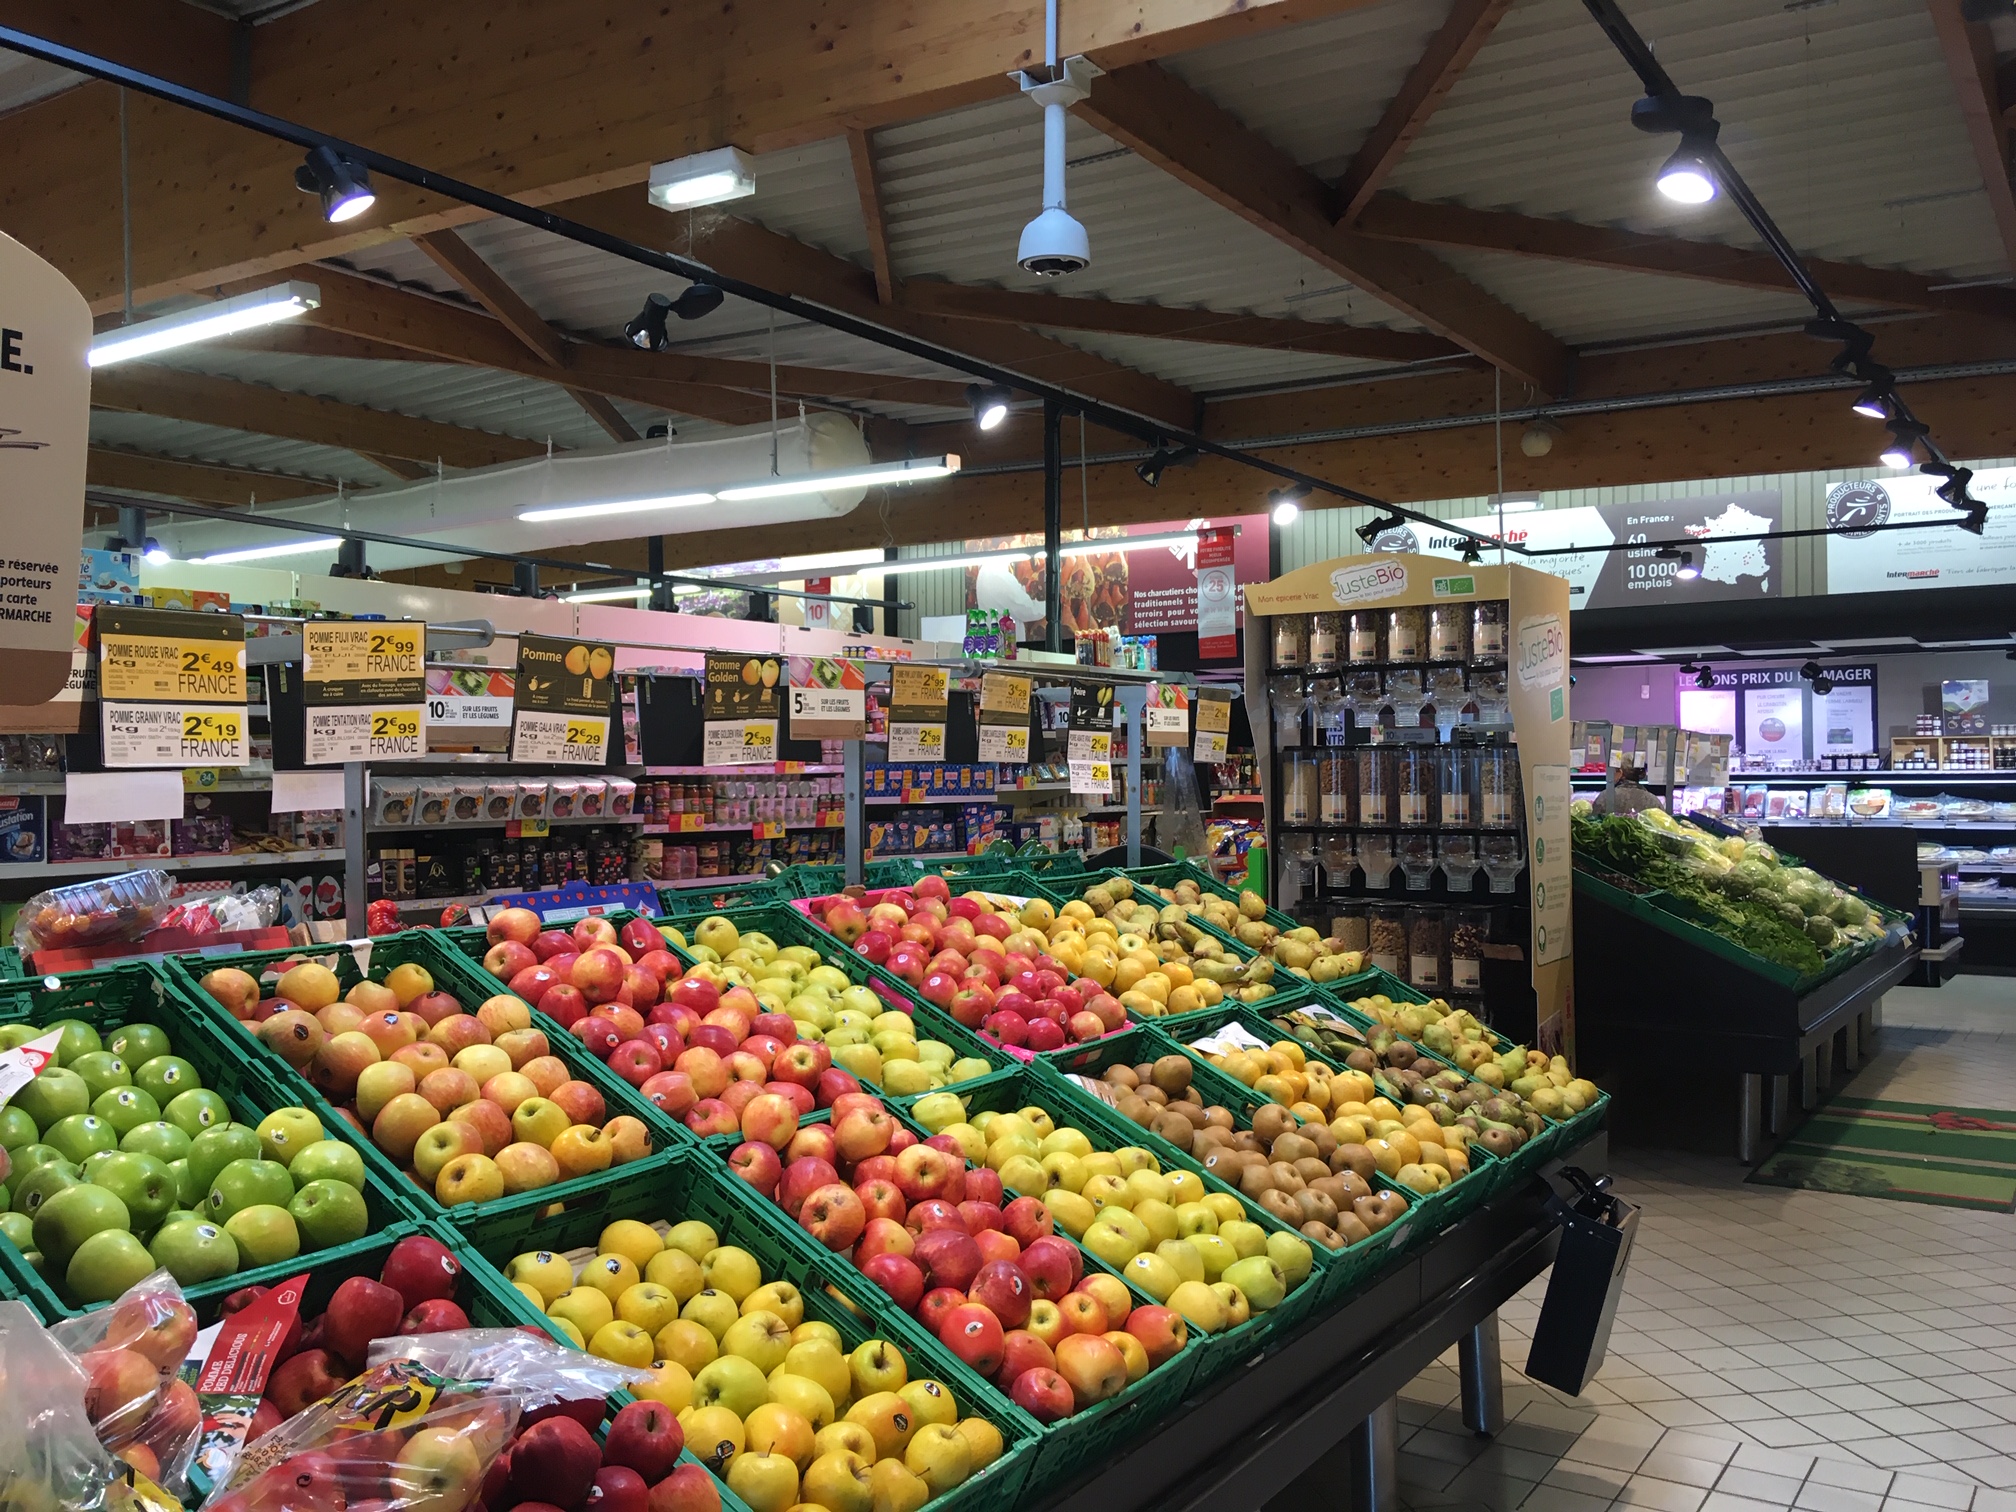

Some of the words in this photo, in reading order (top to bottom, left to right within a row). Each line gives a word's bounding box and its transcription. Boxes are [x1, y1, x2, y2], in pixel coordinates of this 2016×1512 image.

[1827, 481, 1877, 515] PRODUCTEURS
[1627, 517, 1638, 525] En
[1640, 515, 1670, 524] France
[1627, 547, 1663, 558] usine
[8, 559, 59, 574] réservée
[1627, 564, 1646, 579] 10
[1886, 568, 1940, 579] Intermarché
[1, 576, 52, 590] porteurs
[1333, 566, 1404, 598] JusteBio
[1627, 577, 1672, 591] emplois
[1133, 590, 1147, 598] Nos
[1147, 587, 1185, 598] charcutiers
[1185, 586, 1198, 595] cho
[1303, 592, 1319, 600] Vrac
[6, 593, 37, 606] carte
[1134, 598, 1183, 608] traditionnels
[1188, 597, 1198, 605] iss
[1134, 609, 1163, 618] terroirs
[1167, 608, 1185, 618] pour
[1134, 619, 1169, 629] sélection
[309, 631, 334, 643] POMME
[335, 631, 350, 643] FUJI
[350, 631, 368, 643] VRAC
[108, 643, 133, 658] POMME
[134, 645, 159, 659] ROUGE
[160, 646, 179, 660] VRAC
[310, 645, 333, 653] kg
[522, 647, 562, 663] Pomme
[1518, 626, 1563, 672] JusteBio
[109, 658, 136, 668] kg
[367, 654, 416, 673] FRANCE
[708, 659, 740, 671] Pomme
[708, 671, 739, 683] Golden
[1712, 674, 1738, 686] ONS
[1741, 672, 1770, 684] PRIX
[1775, 671, 1793, 683] DU
[178, 673, 237, 695] FRANCE
[921, 687, 945, 700] FRANCE
[1073, 686, 1086, 697] Poire
[1005, 696, 1026, 710] FRANCE
[110, 710, 134, 723] POMME
[135, 710, 162, 724] GRANNY
[163, 711, 181, 724] VRAC
[312, 715, 330, 727] POMME
[331, 714, 357, 726] TENTATION
[358, 714, 371, 726] VRAC
[111, 725, 139, 734] kg
[313, 728, 336, 736] kg
[520, 721, 538, 731] POMME
[539, 721, 551, 732] GALA
[552, 723, 566, 733] VRAC
[520, 732, 537, 740] kg
[180, 737, 240, 758] FRANCE
[370, 735, 418, 755] FRANCE
[918, 743, 941, 756] FRANCE
[562, 744, 601, 761] FRANCE
[741, 746, 772, 760] FRANCE
[1004, 746, 1025, 759] FRANCE
[1091, 778, 1109, 789] FRANCE
[220, 1332, 248, 1375] DELICIOUS
[200, 1360, 224, 1392] POMME
[212, 1375, 229, 1392] RED
